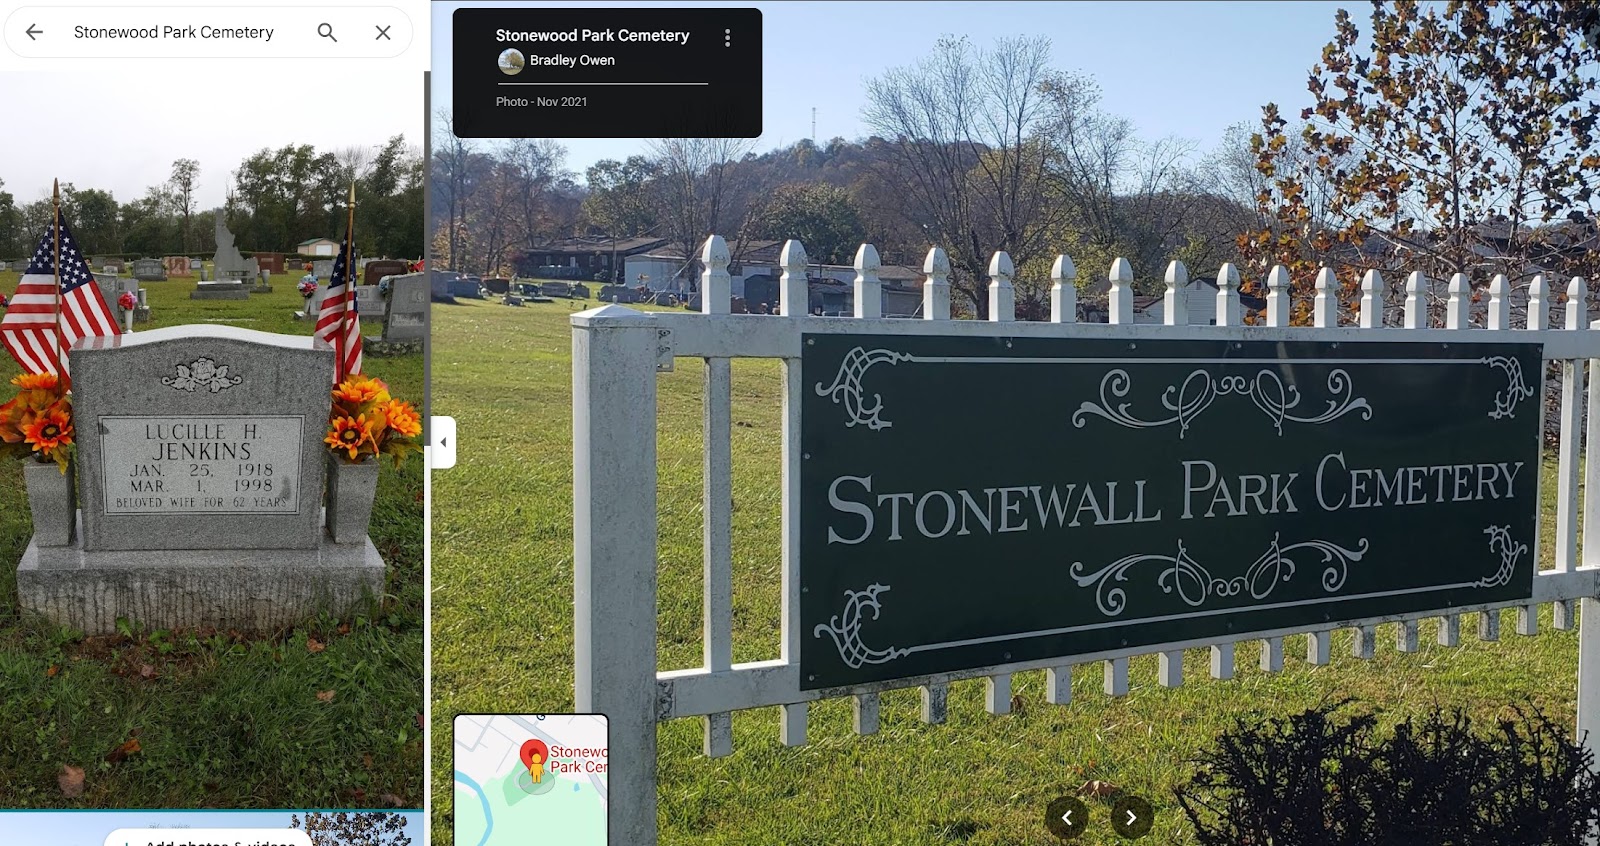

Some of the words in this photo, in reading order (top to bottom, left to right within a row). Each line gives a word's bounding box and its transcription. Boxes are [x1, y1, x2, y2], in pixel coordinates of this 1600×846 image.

[74, 24, 158, 39] Stonewood
[163, 24, 197, 39] Park
[200, 24, 275, 42] Cemetery
[495, 28, 578, 43] Stonewood
[581, 28, 615, 42] Park
[617, 28, 690, 45] Cemetery
[530, 54, 577, 68] Bradley
[579, 54, 616, 66] Owen
[496, 96, 529, 107] Photo
[537, 96, 559, 107] Nov
[561, 96, 588, 107] 2021
[146, 424, 226, 440] LUCILLE
[244, 424, 262, 440] H.
[152, 442, 251, 461] JENKINS
[130, 464, 166, 477] JAN.
[238, 463, 273, 477] 1918
[130, 480, 169, 492] MAR.
[235, 479, 273, 492] 1998
[116, 497, 162, 508] BELOVED
[170, 497, 195, 507] WIFE
[204, 497, 224, 507] FOR
[233, 497, 245, 507] 62
[254, 496, 287, 508] YEARS
[827, 475, 1162, 545] STONEWALL
[1181, 460, 1299, 519] PARK
[1314, 451, 1524, 511] CEMETERY
[551, 760, 581, 773] Park
